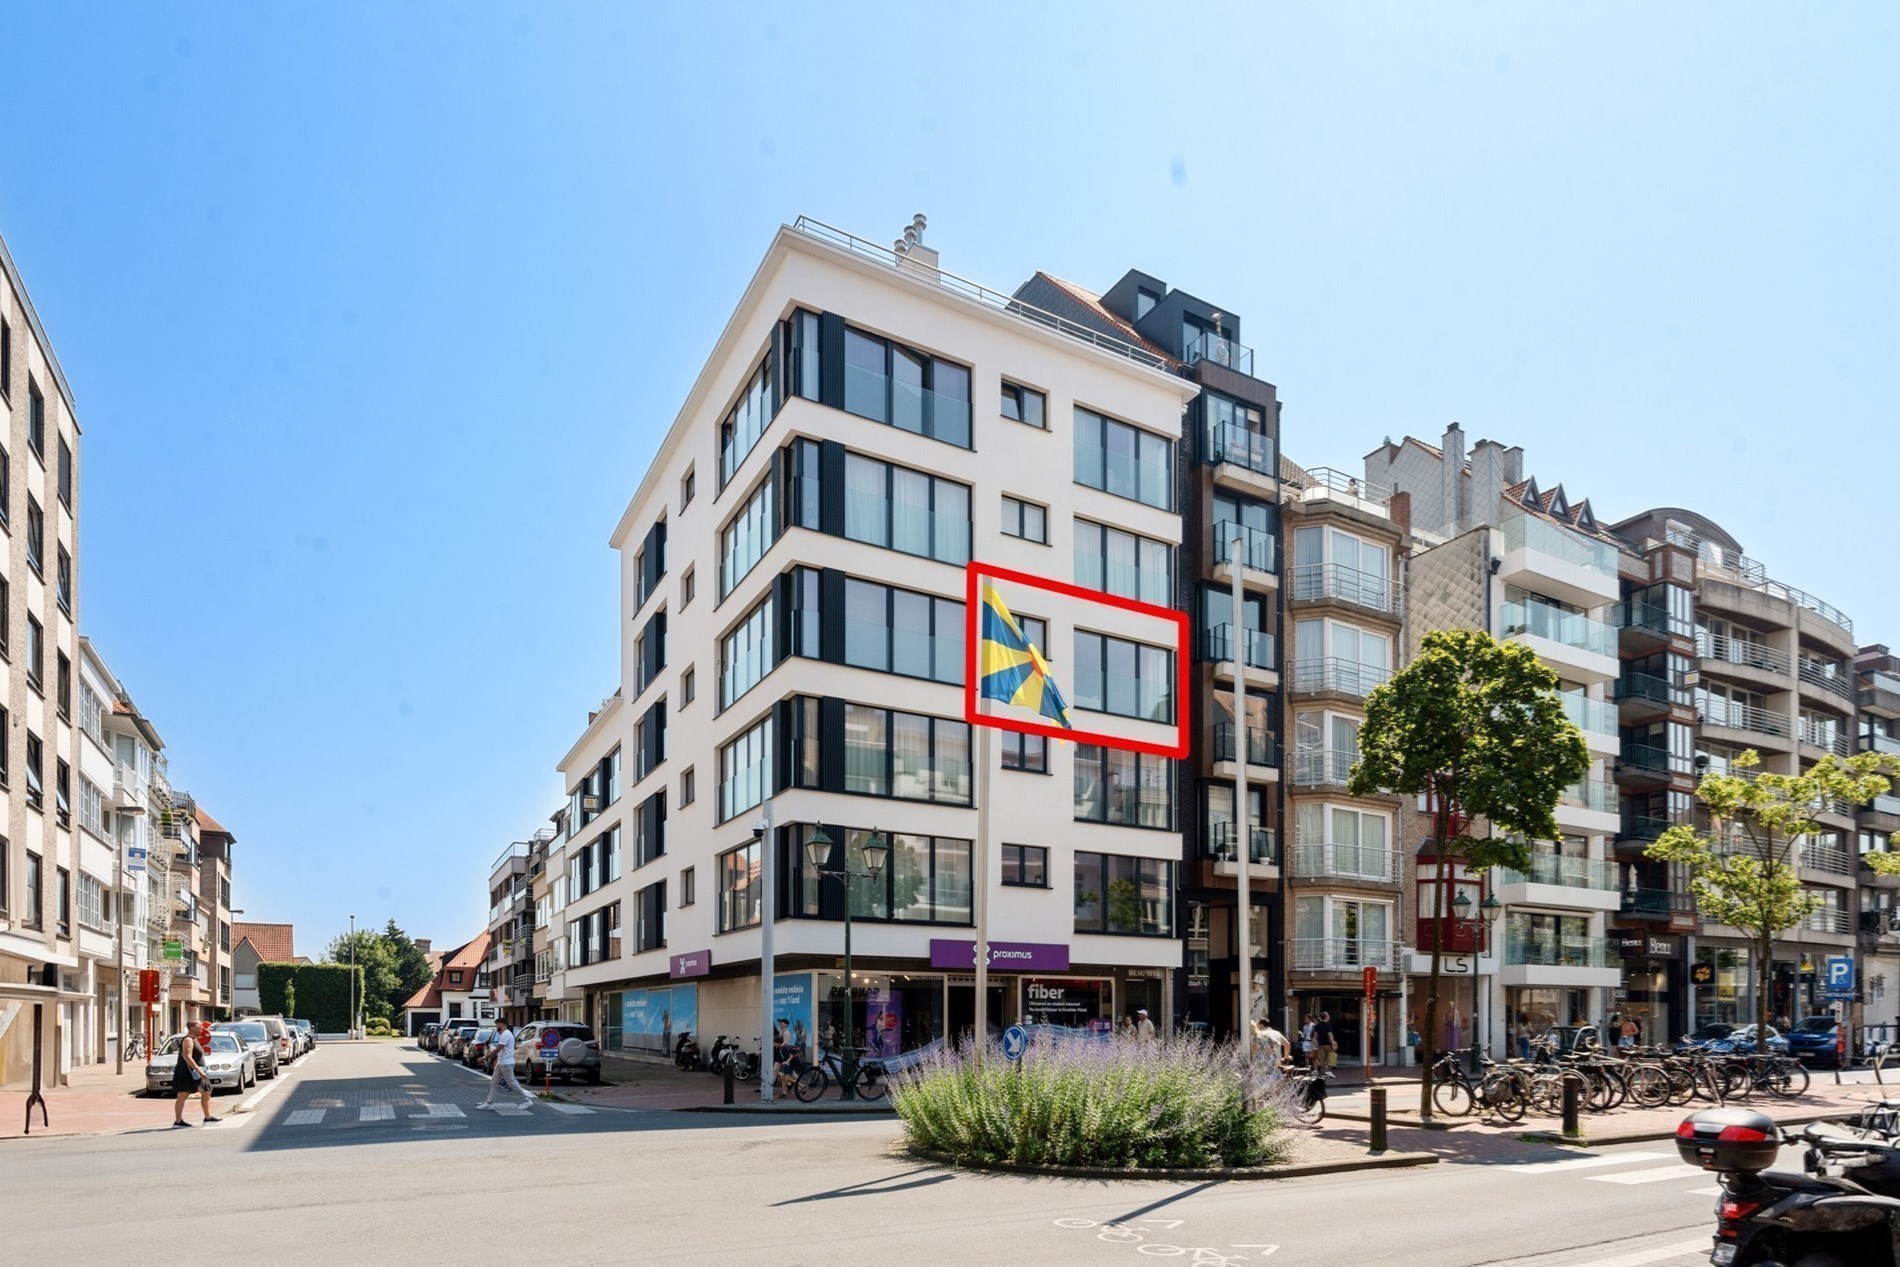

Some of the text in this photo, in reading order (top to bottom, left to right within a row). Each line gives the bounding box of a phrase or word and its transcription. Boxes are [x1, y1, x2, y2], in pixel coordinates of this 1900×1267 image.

[1621, 938, 1642, 947] Beau
[1648, 938, 1672, 954] Beau
[993, 950, 1032, 960] proximus
[1445, 957, 1467, 972] LS
[1831, 963, 1849, 985] P
[1027, 983, 1065, 1000] fiber
